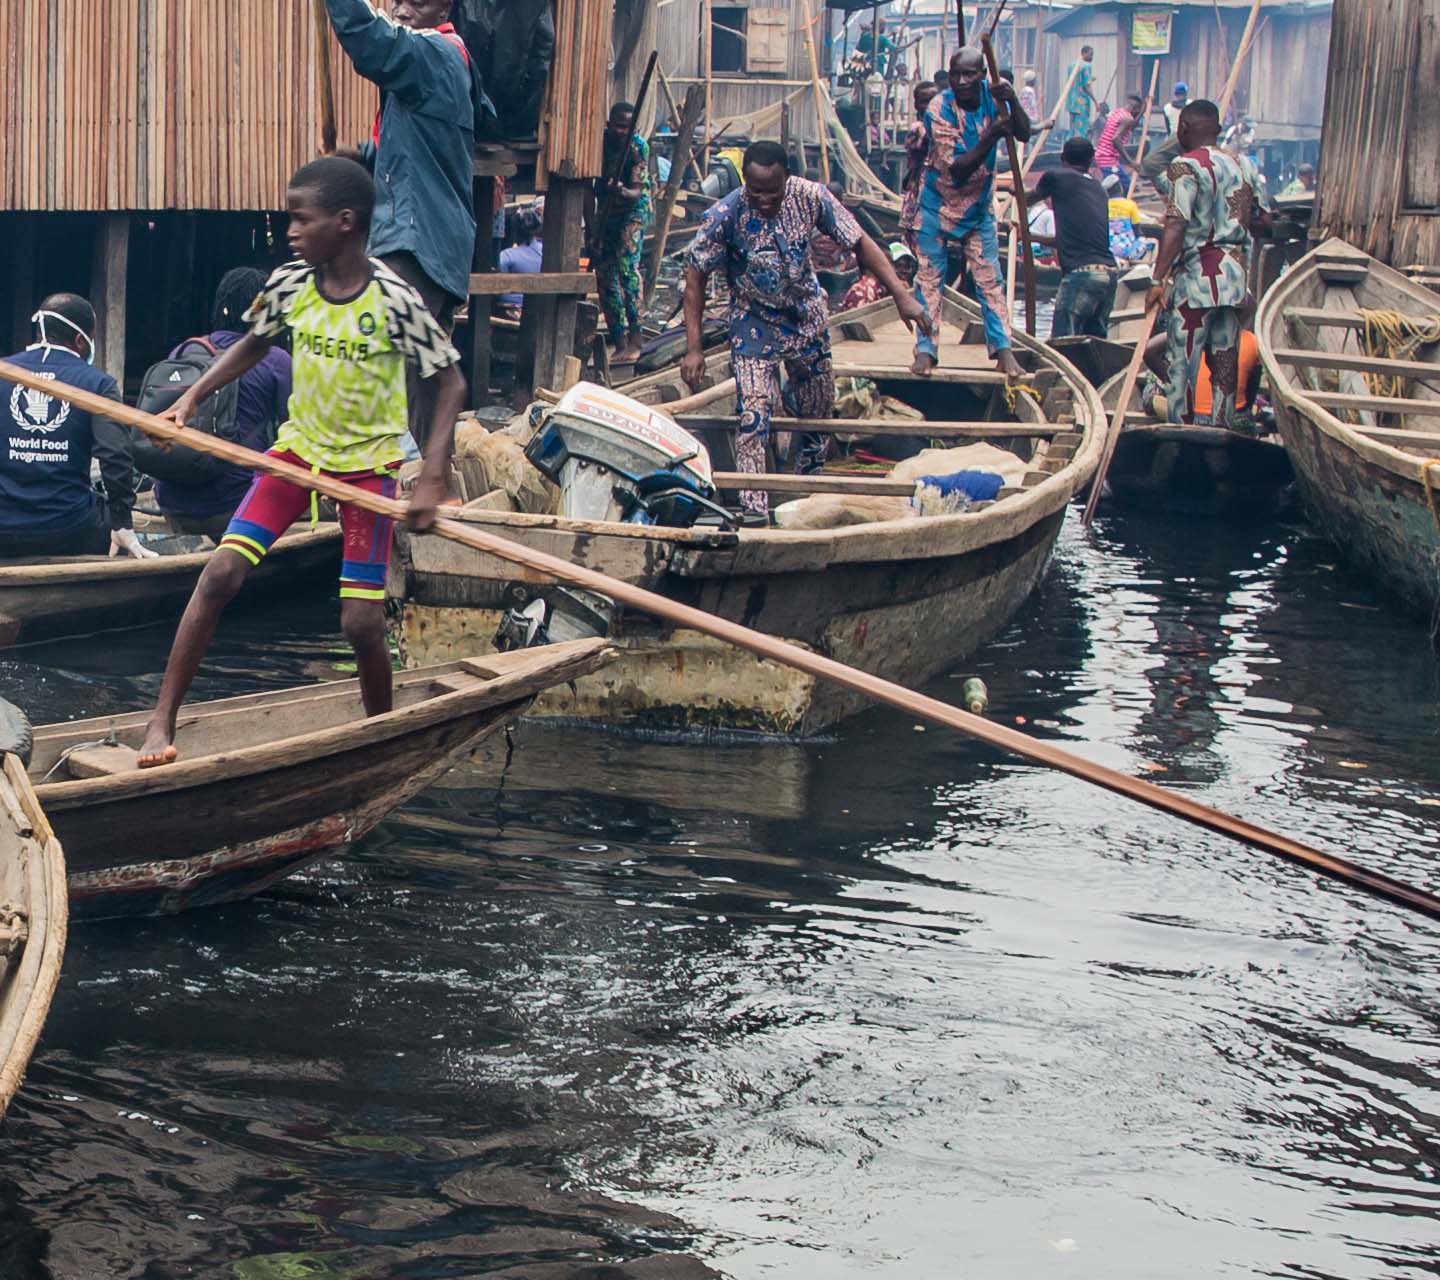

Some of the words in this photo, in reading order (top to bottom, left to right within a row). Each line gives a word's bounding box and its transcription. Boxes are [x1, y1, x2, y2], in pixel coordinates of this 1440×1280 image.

[8, 437, 40, 449] World
[41, 439, 69, 450] Food
[8, 449, 69, 463] Programme
